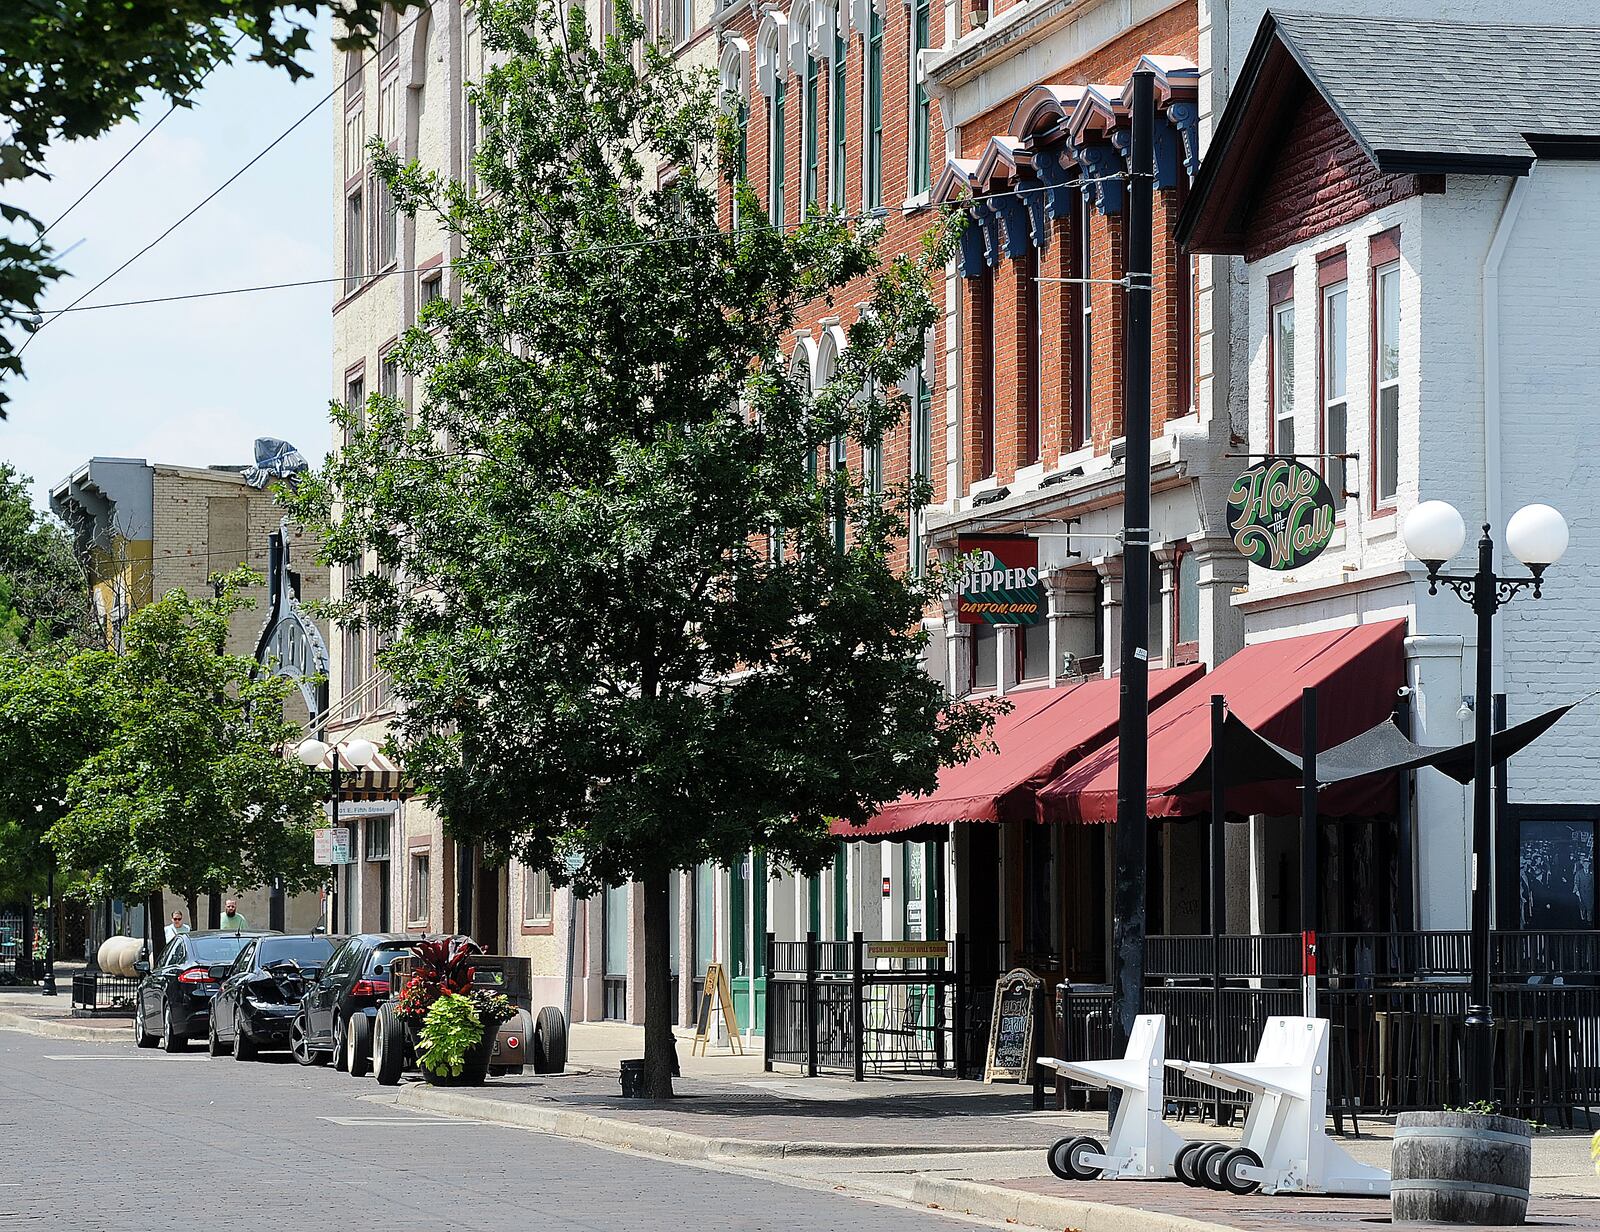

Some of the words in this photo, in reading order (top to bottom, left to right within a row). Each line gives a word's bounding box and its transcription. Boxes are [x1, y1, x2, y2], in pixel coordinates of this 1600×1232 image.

[1227, 460, 1317, 529] Hole
[1273, 511, 1283, 522] IN
[1273, 521, 1286, 534] THE
[1233, 496, 1332, 568] Wall
[959, 566, 1038, 596] PEPPERS
